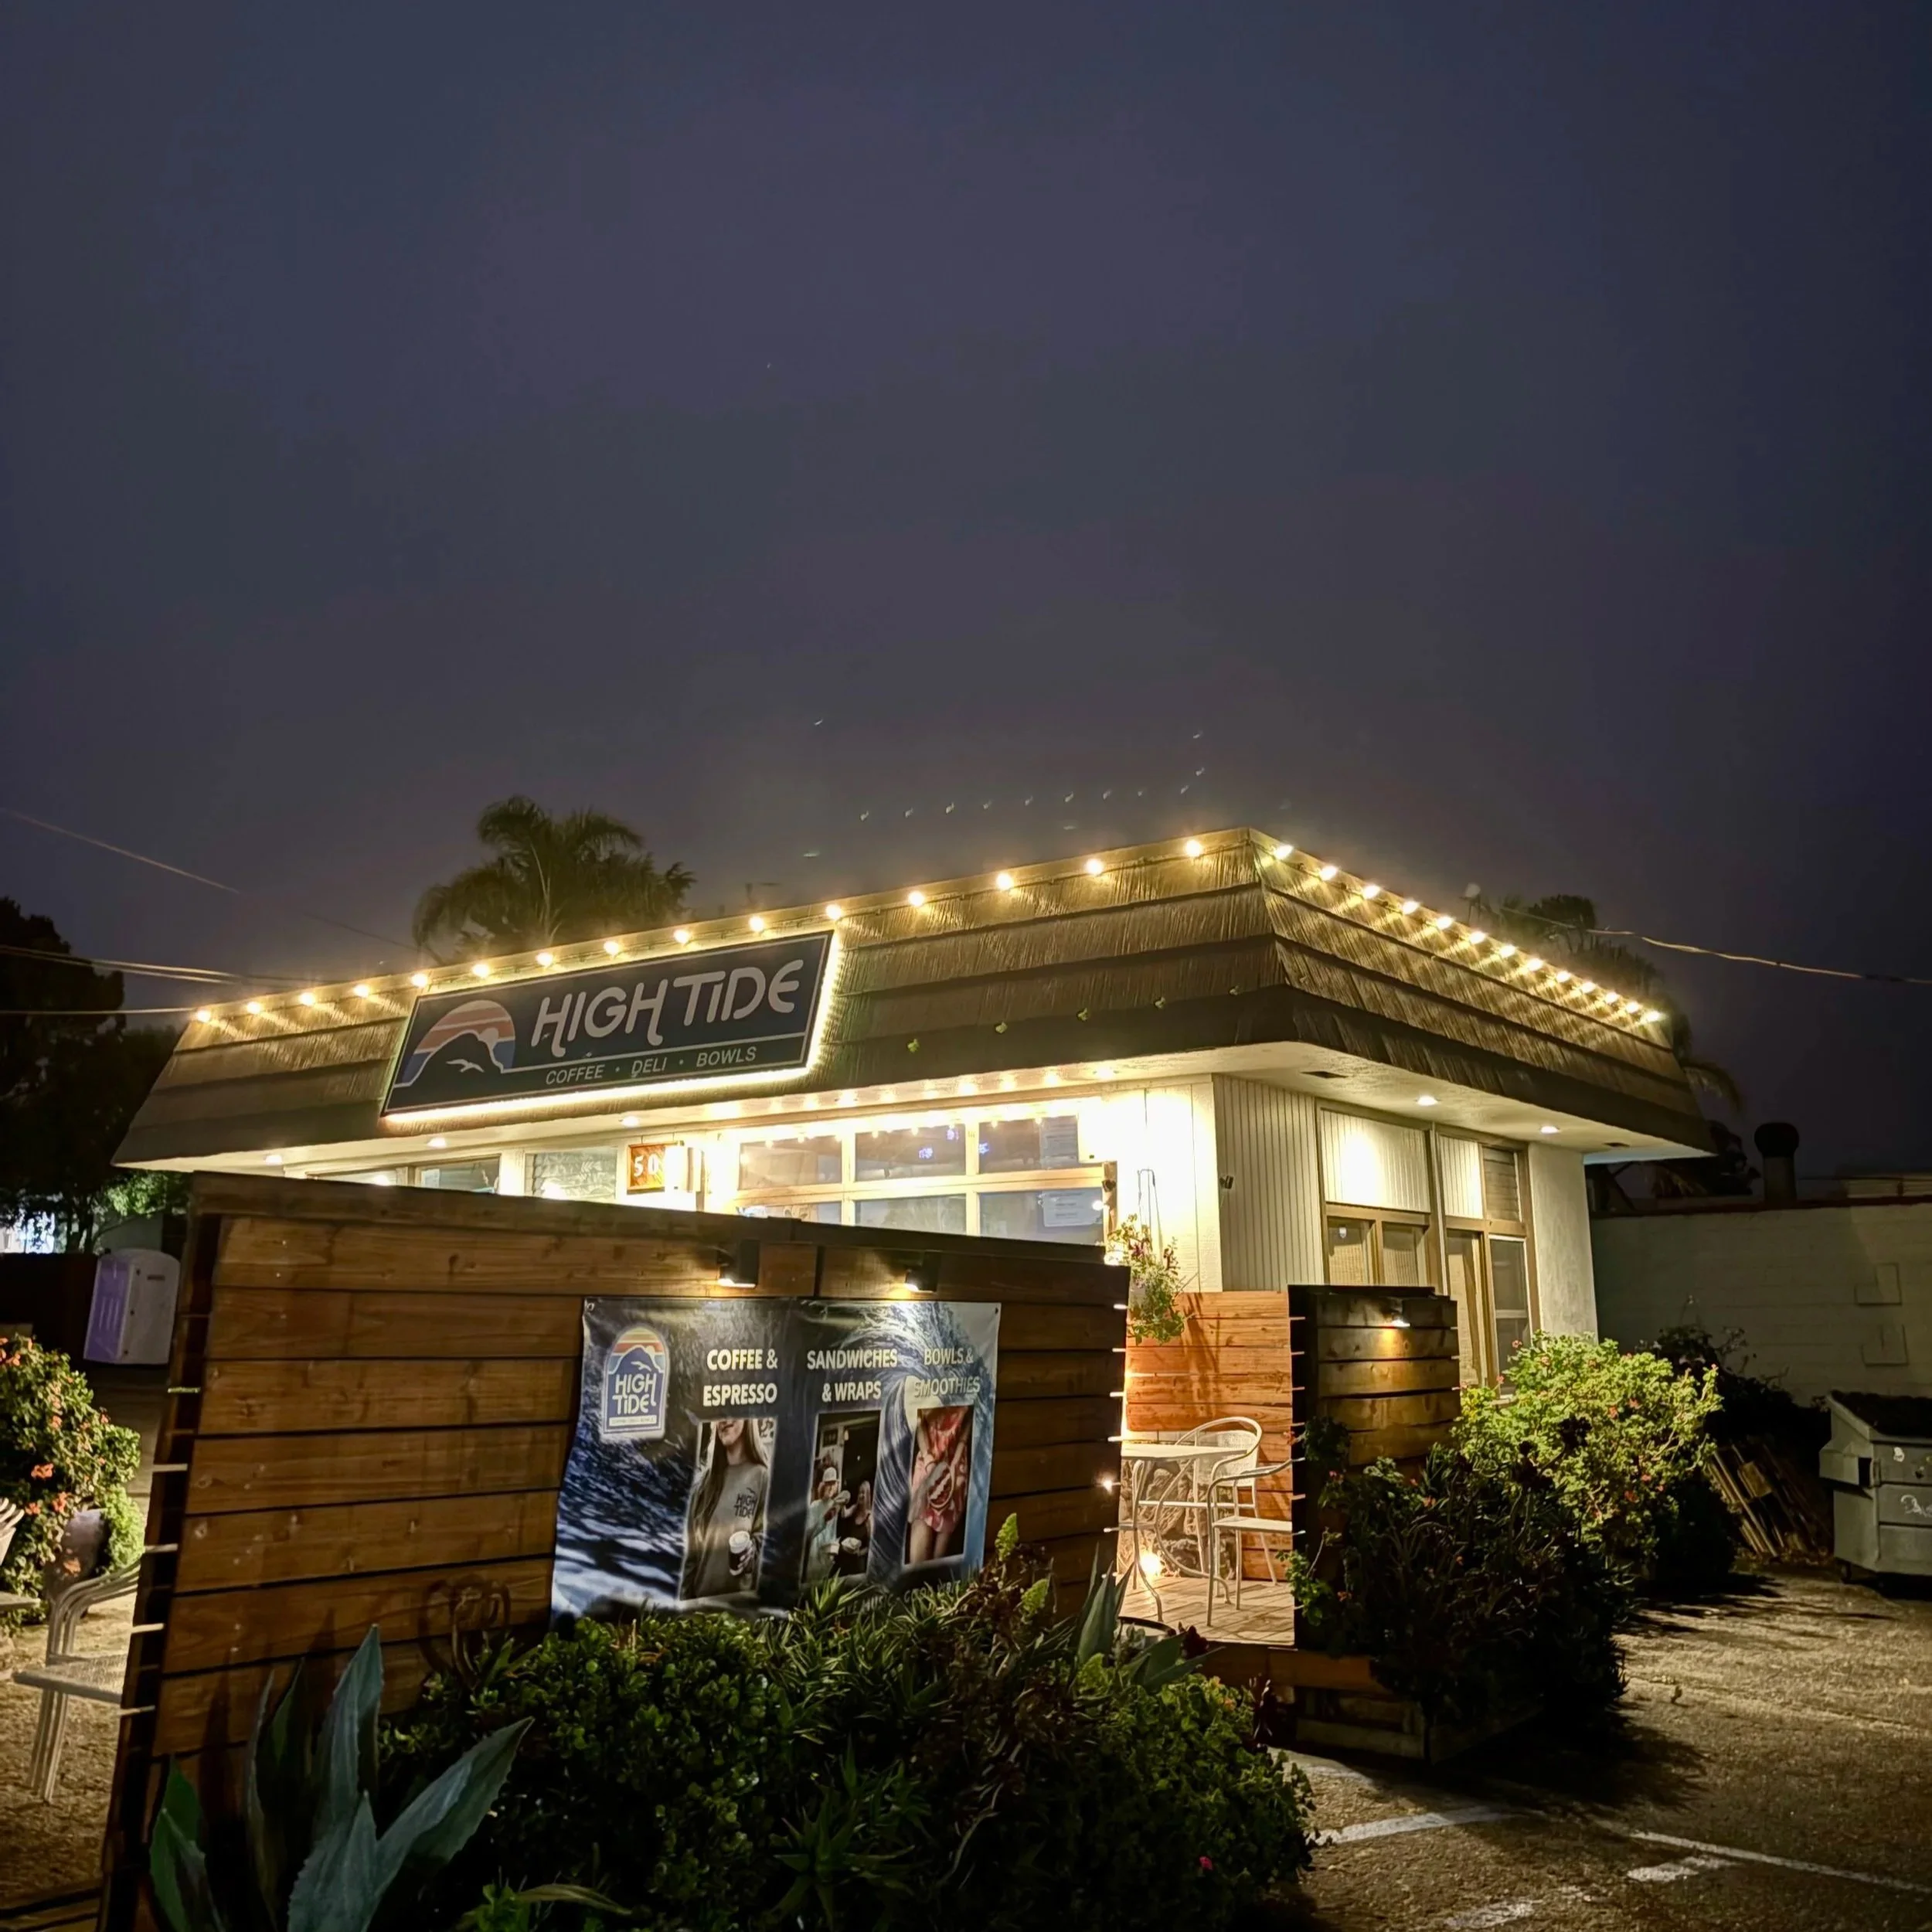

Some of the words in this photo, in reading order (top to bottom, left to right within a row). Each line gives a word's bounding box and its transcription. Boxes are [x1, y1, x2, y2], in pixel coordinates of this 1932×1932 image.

[531, 979, 668, 1058] HIGH
[674, 959, 804, 1026] TIDE
[546, 1064, 606, 1086] COFFEE
[631, 1056, 668, 1075] DELI
[696, 1046, 757, 1068] BOWLS
[706, 1349, 764, 1371] COFFEE
[766, 1348, 779, 1369] &
[807, 1348, 898, 1370] SANDWICHES
[923, 1348, 964, 1366] BOWLS
[966, 1347, 974, 1363] &
[615, 1372, 657, 1406] HIGH
[702, 1383, 778, 1407] ESPRESSO
[821, 1382, 832, 1402] &
[835, 1380, 882, 1403] WRAPS
[914, 1376, 980, 1398] SMOOTHIES
[612, 1393, 650, 1415] TIDE
